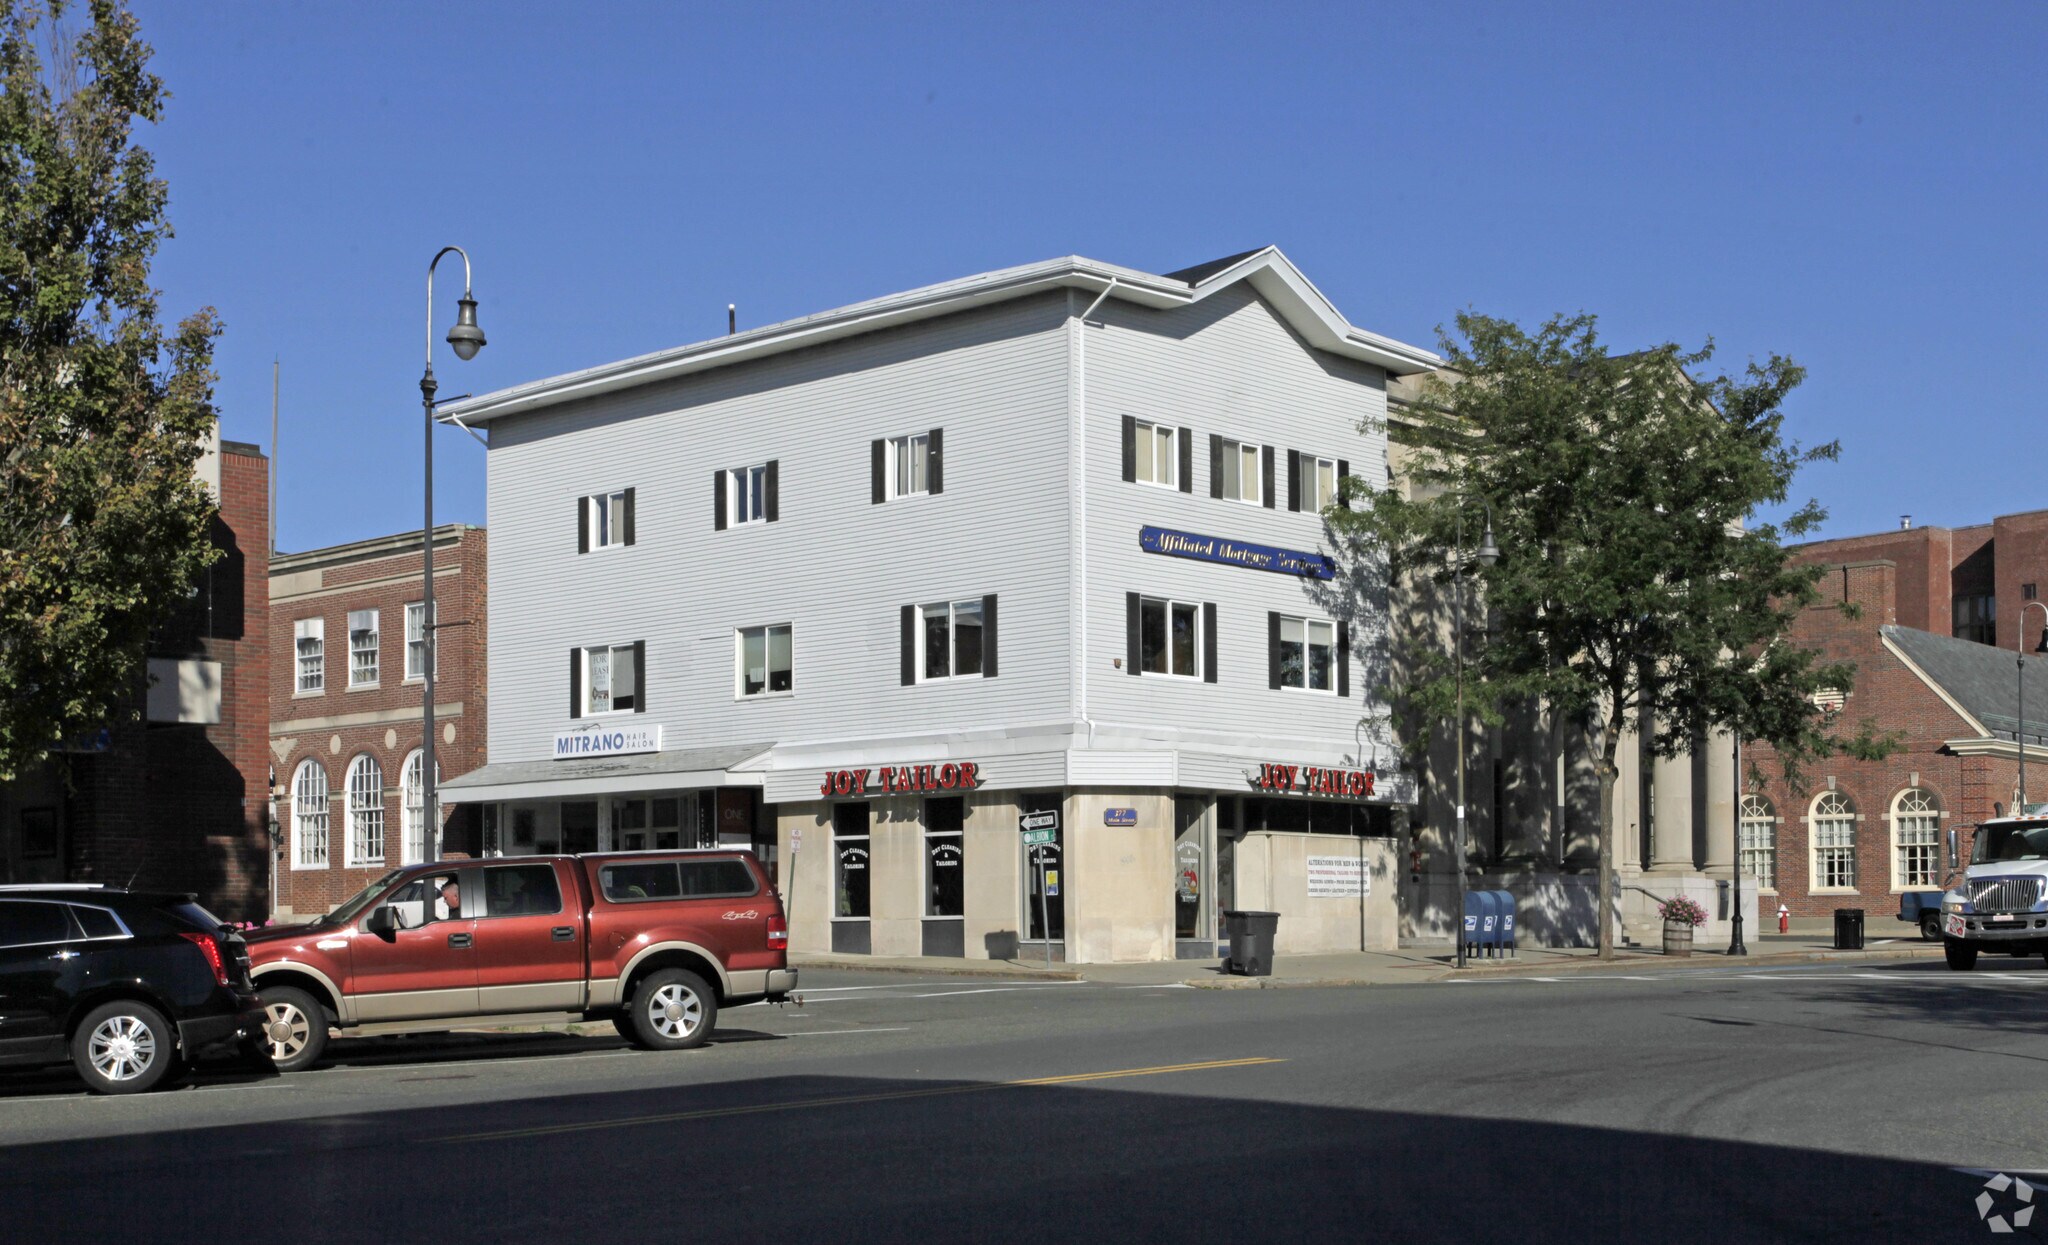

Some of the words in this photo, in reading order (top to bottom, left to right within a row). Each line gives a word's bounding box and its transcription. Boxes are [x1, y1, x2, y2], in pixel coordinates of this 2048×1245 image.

[1155, 532, 1214, 556] Affiliated
[1220, 543, 1272, 566] Mortgage
[592, 655, 606, 664] FOR
[627, 732, 646, 740] HAIR
[558, 732, 624, 754] MITRANO
[626, 740, 654, 749] SALON
[820, 768, 867, 796] JOY
[880, 762, 976, 792] TAILOR
[1260, 763, 1298, 790] JOY
[1308, 767, 1376, 797] TAILOR
[1030, 818, 1040, 826] ONE
[1041, 816, 1052, 824] WAY
[722, 909, 758, 920] 4x4
